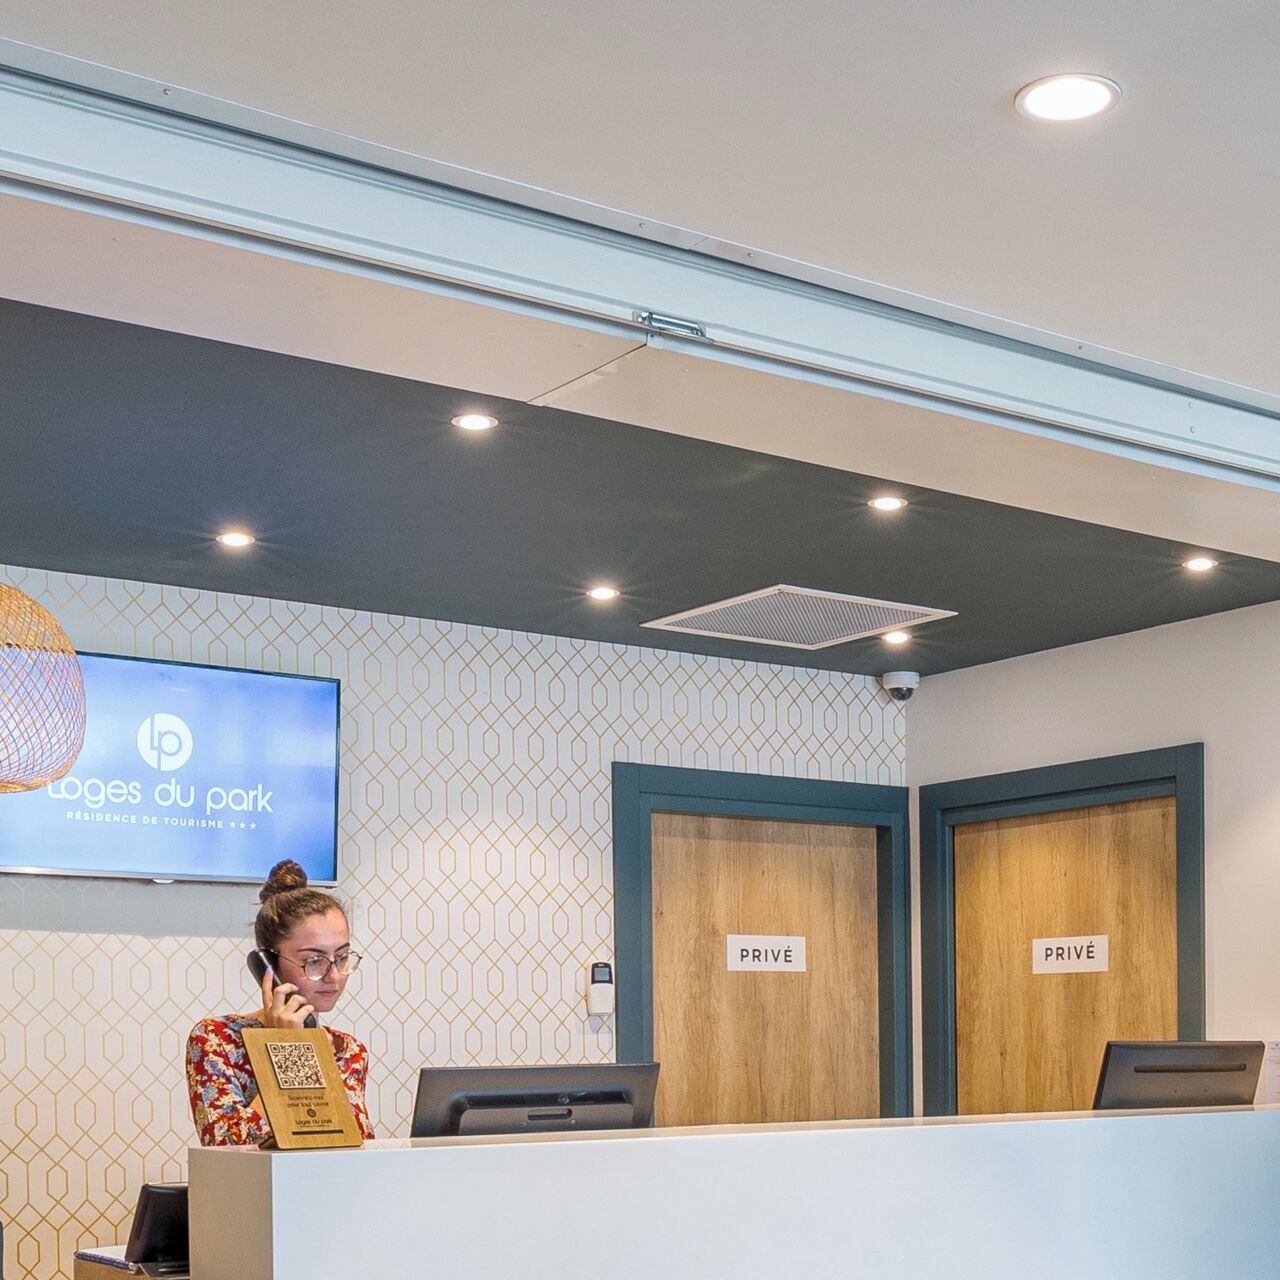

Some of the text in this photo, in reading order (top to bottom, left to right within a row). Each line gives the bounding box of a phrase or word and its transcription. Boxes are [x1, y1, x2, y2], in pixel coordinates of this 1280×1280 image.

[154, 777, 195, 808] du
[206, 784, 274, 815] park
[66, 810, 224, 829] RÉSIDENCE DE TOURISME
[740, 946, 793, 963] PRIVÉ
[1045, 941, 1095, 961] PRIVÉ
